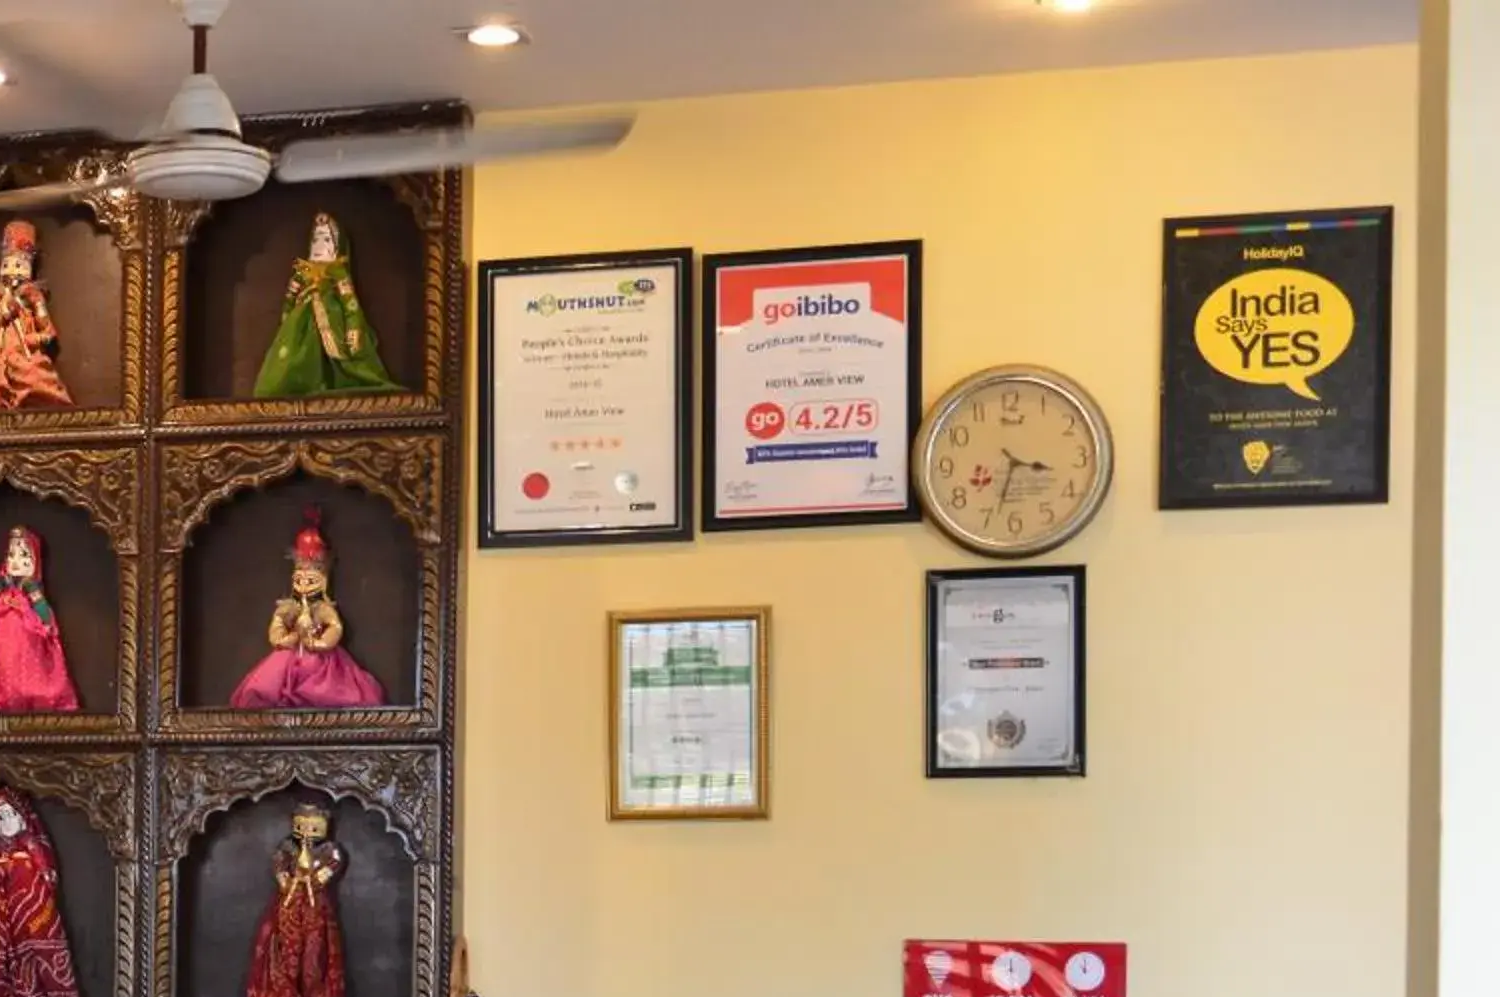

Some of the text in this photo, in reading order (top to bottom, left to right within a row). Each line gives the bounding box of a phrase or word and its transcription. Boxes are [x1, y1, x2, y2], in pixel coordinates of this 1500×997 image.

[1243, 244, 1305, 262] HolidayIQ
[764, 292, 861, 326] goibibo
[1230, 284, 1321, 320] India
[1215, 315, 1269, 338] Says
[1230, 330, 1322, 370] YES
[837, 373, 866, 386] VIEW
[972, 402, 986, 423] 11
[1001, 391, 1019, 412] 12
[1041, 394, 1046, 417] 1
[751, 402, 874, 431] go 4.2/5
[1062, 414, 1076, 437] 2
[950, 425, 970, 448] 10
[939, 457, 954, 479] 9
[1072, 446, 1088, 470] 3
[951, 486, 967, 510] 8
[1060, 480, 1085, 500] 4
[979, 507, 994, 530] 7
[1007, 511, 1024, 536] 6
[1039, 501, 1056, 526] 5
